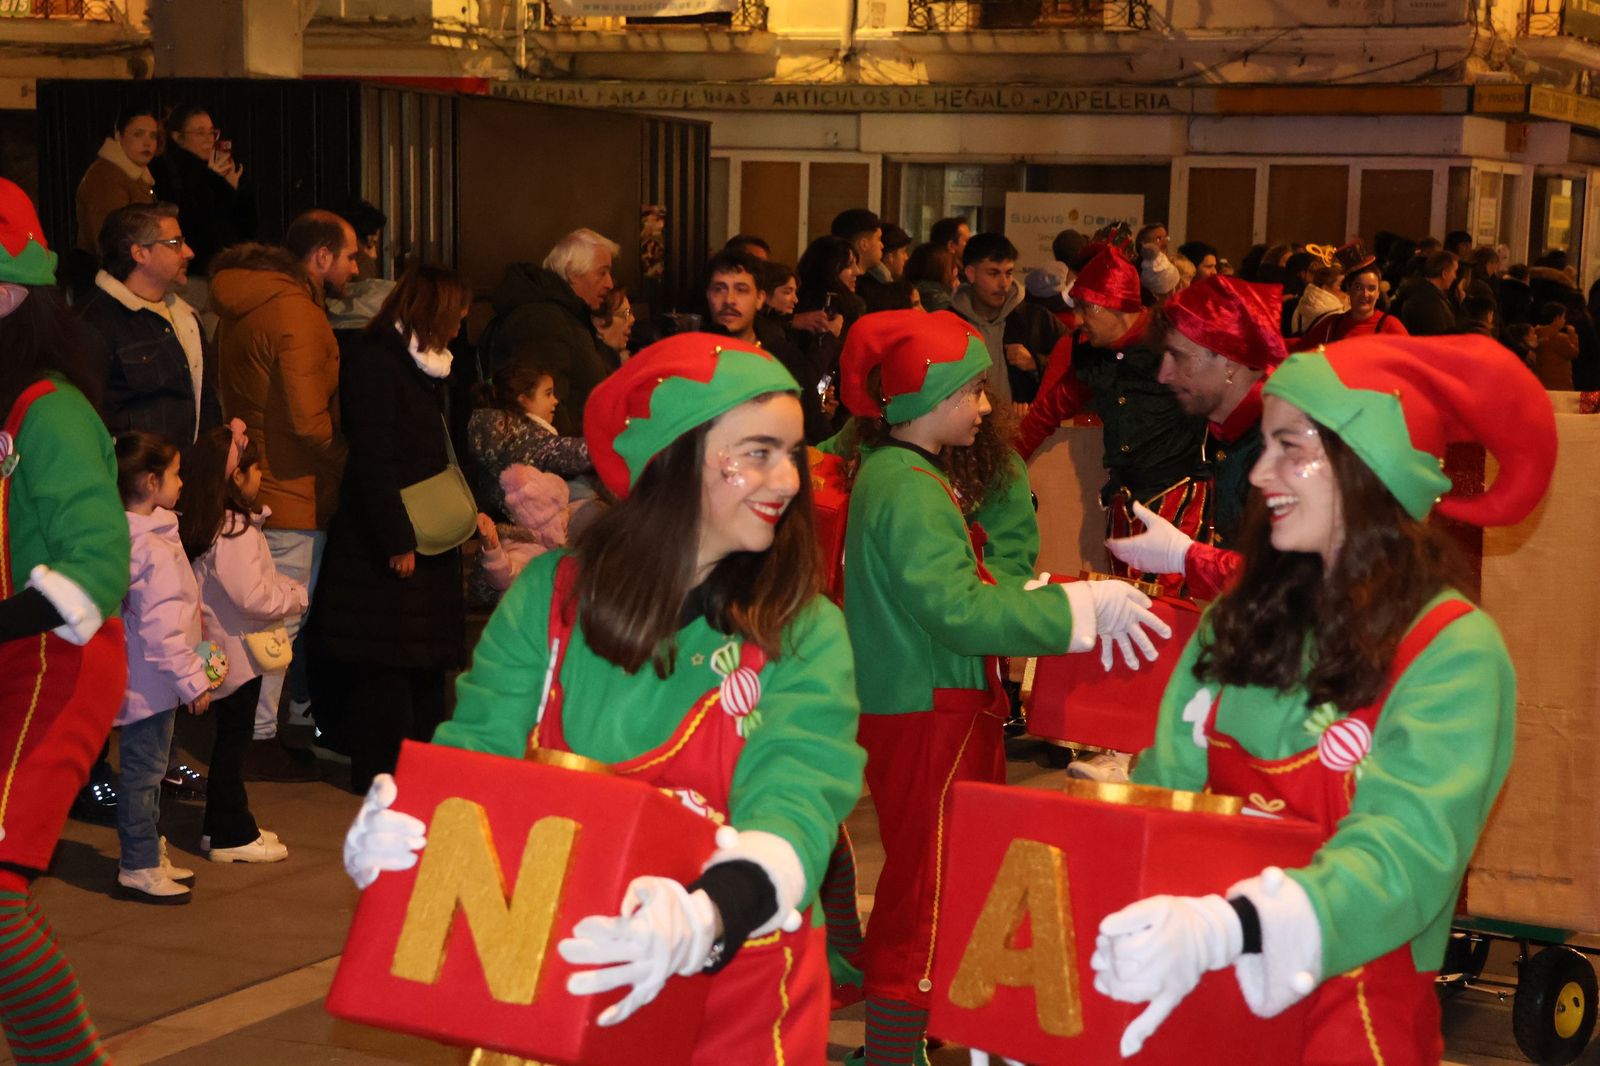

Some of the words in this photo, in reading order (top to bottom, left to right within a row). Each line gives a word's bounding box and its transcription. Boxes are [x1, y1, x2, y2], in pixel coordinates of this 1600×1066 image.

[492, 84, 590, 104] MATERIAL
[772, 89, 891, 107] ARTICULOS
[899, 89, 926, 107] DE
[935, 89, 1025, 108] REGALO
[1046, 90, 1171, 109] PAPELERIA
[1010, 213, 1065, 225] SUAVIS
[390, 796, 582, 1006] N
[947, 837, 1085, 1038] A
